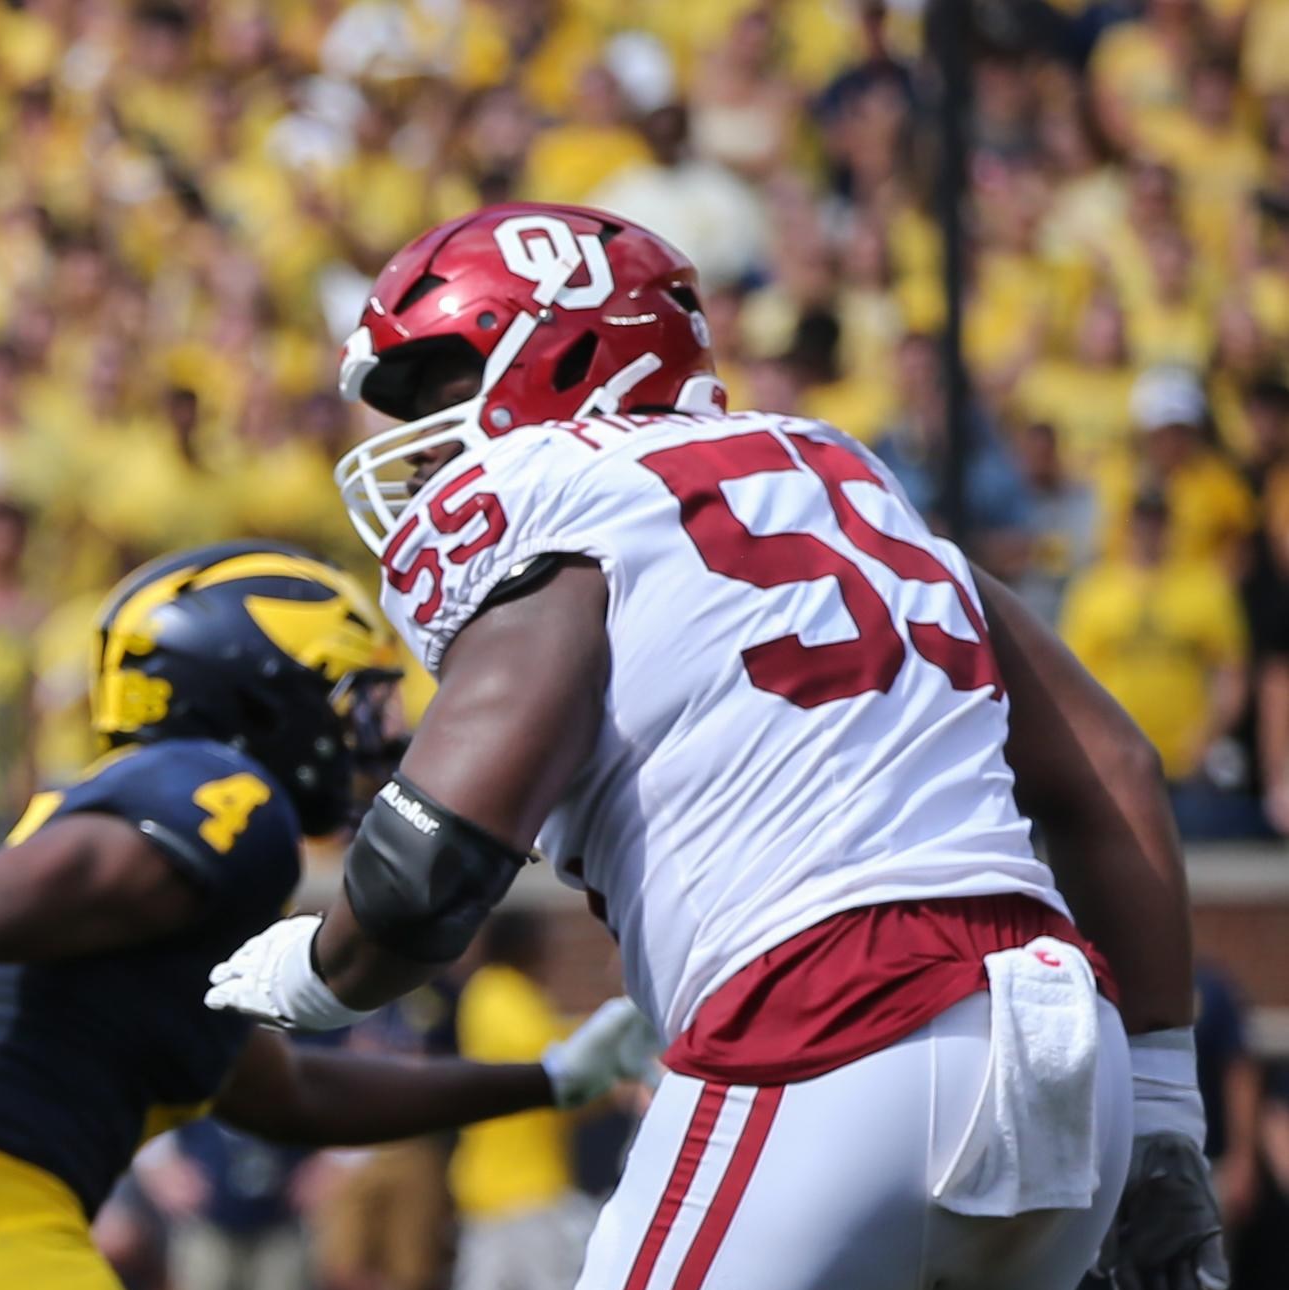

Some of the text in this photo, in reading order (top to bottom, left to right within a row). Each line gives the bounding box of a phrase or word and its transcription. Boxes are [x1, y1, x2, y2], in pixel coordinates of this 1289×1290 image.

[493, 214, 615, 310] OU
[381, 464, 508, 624] 55
[638, 431, 1008, 710] 55
[191, 772, 271, 854] 4
[378, 780, 441, 834] Mueller
